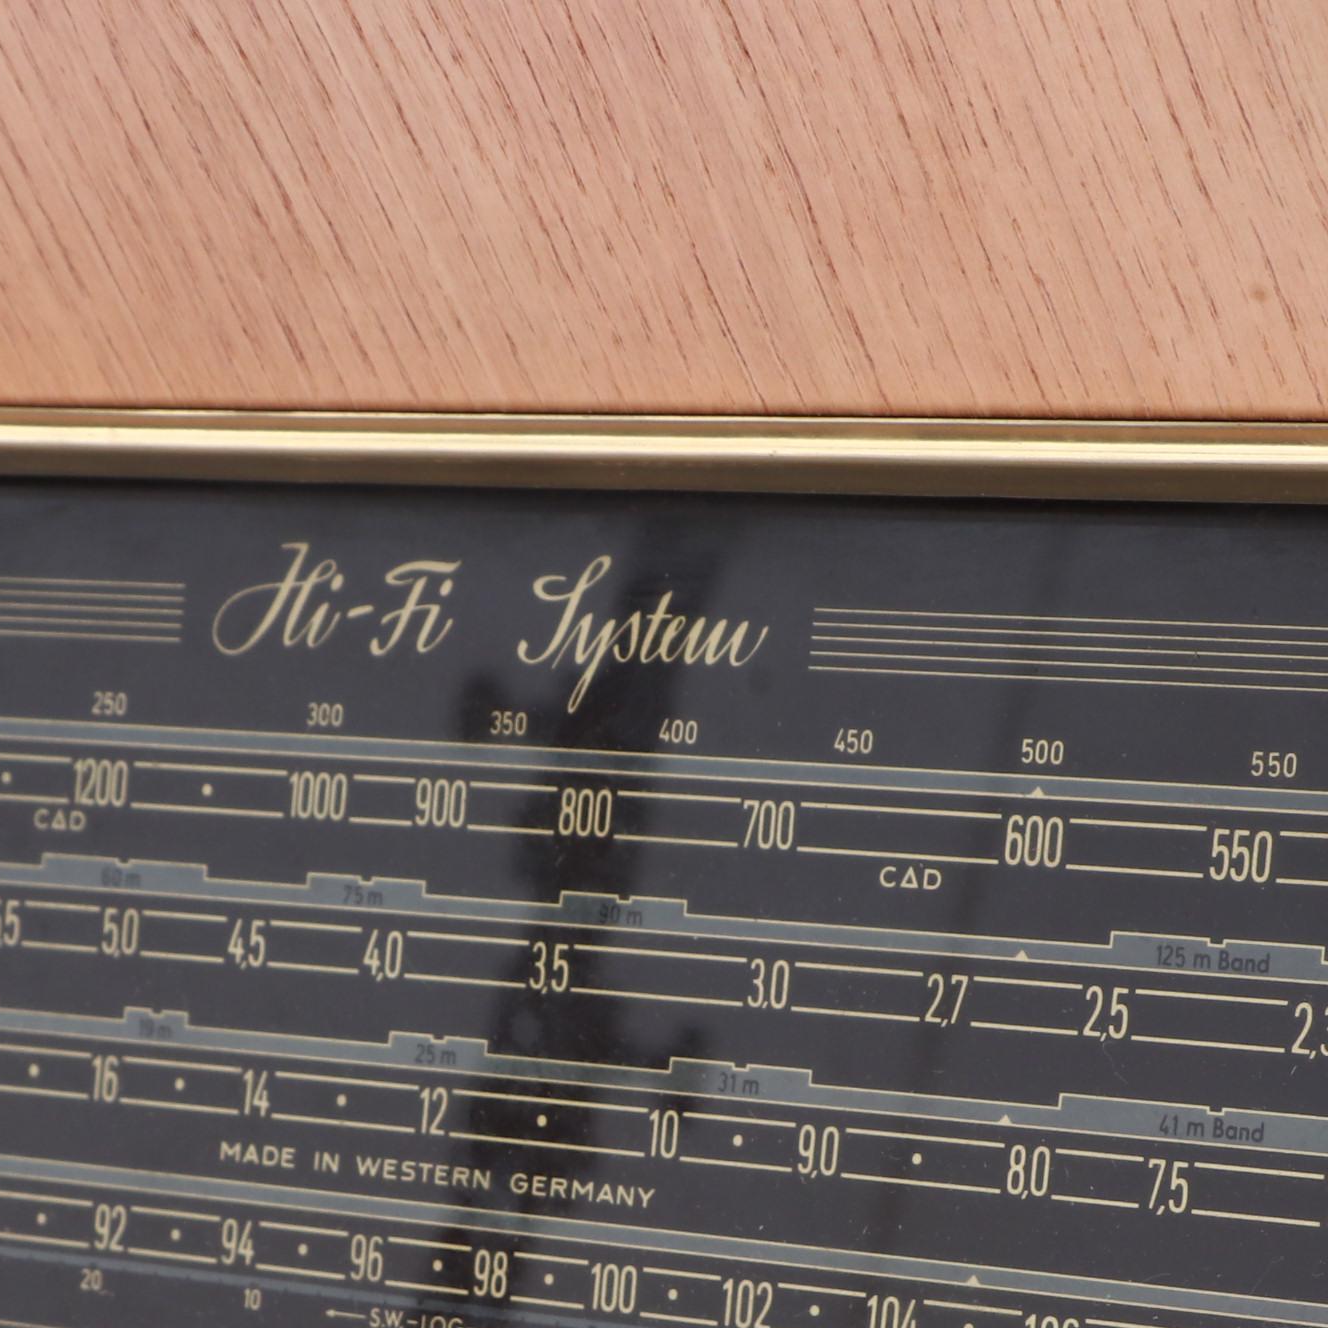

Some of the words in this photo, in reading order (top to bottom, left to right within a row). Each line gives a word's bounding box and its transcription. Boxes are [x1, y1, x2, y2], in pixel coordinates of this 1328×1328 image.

[213, 543, 461, 655] Hi-Fi
[518, 555, 769, 712] System
[92, 692, 127, 715] 250
[307, 703, 343, 726] 300
[490, 712, 527, 736] 350
[659, 720, 698, 744] 400
[834, 729, 873, 754] 450
[1021, 740, 1064, 766] 500
[1251, 752, 1298, 778] 550
[72, 760, 128, 806] 1200
[289, 772, 347, 820] 1000
[415, 778, 466, 829] 900
[558, 789, 612, 836] 800
[743, 801, 796, 851] 700
[1005, 816, 1063, 867] 600
[1210, 830, 1273, 881] 550
[102, 908, 140, 956] 5,0
[228, 919, 267, 969] 4,5
[363, 930, 403, 981] 4,0
[528, 942, 569, 993] 3,5
[746, 959, 790, 1011] 3,0
[924, 974, 968, 1028] 2,7
[1083, 985, 1129, 1041] 2,5
[1157, 944, 1184, 966] 125
[1188, 952, 1211, 968] m
[1218, 950, 1271, 974] Band
[93, 1055, 119, 1102] 16
[242, 1069, 270, 1116] 14
[420, 1087, 448, 1135] 12
[649, 1110, 678, 1158] 10
[797, 1124, 839, 1178] 9,0
[1006, 1145, 1050, 1199] 8,0
[1147, 1159, 1190, 1217] 7,5
[220, 1141, 296, 1169] MADE
[314, 1151, 339, 1172] IN
[356, 1155, 491, 1189] WESTERN
[509, 1173, 656, 1209] GERMANY
[1159, 1116, 1182, 1138] 41
[1187, 1123, 1208, 1139] m
[1213, 1119, 1264, 1144] Band
[81, 1269, 102, 1290] 20
[244, 1289, 261, 1309] 10
[94, 1205, 127, 1251] 92
[221, 1219, 254, 1266] 94
[351, 1234, 383, 1282] 96
[474, 1250, 508, 1299] 98
[590, 1264, 638, 1315] 100
